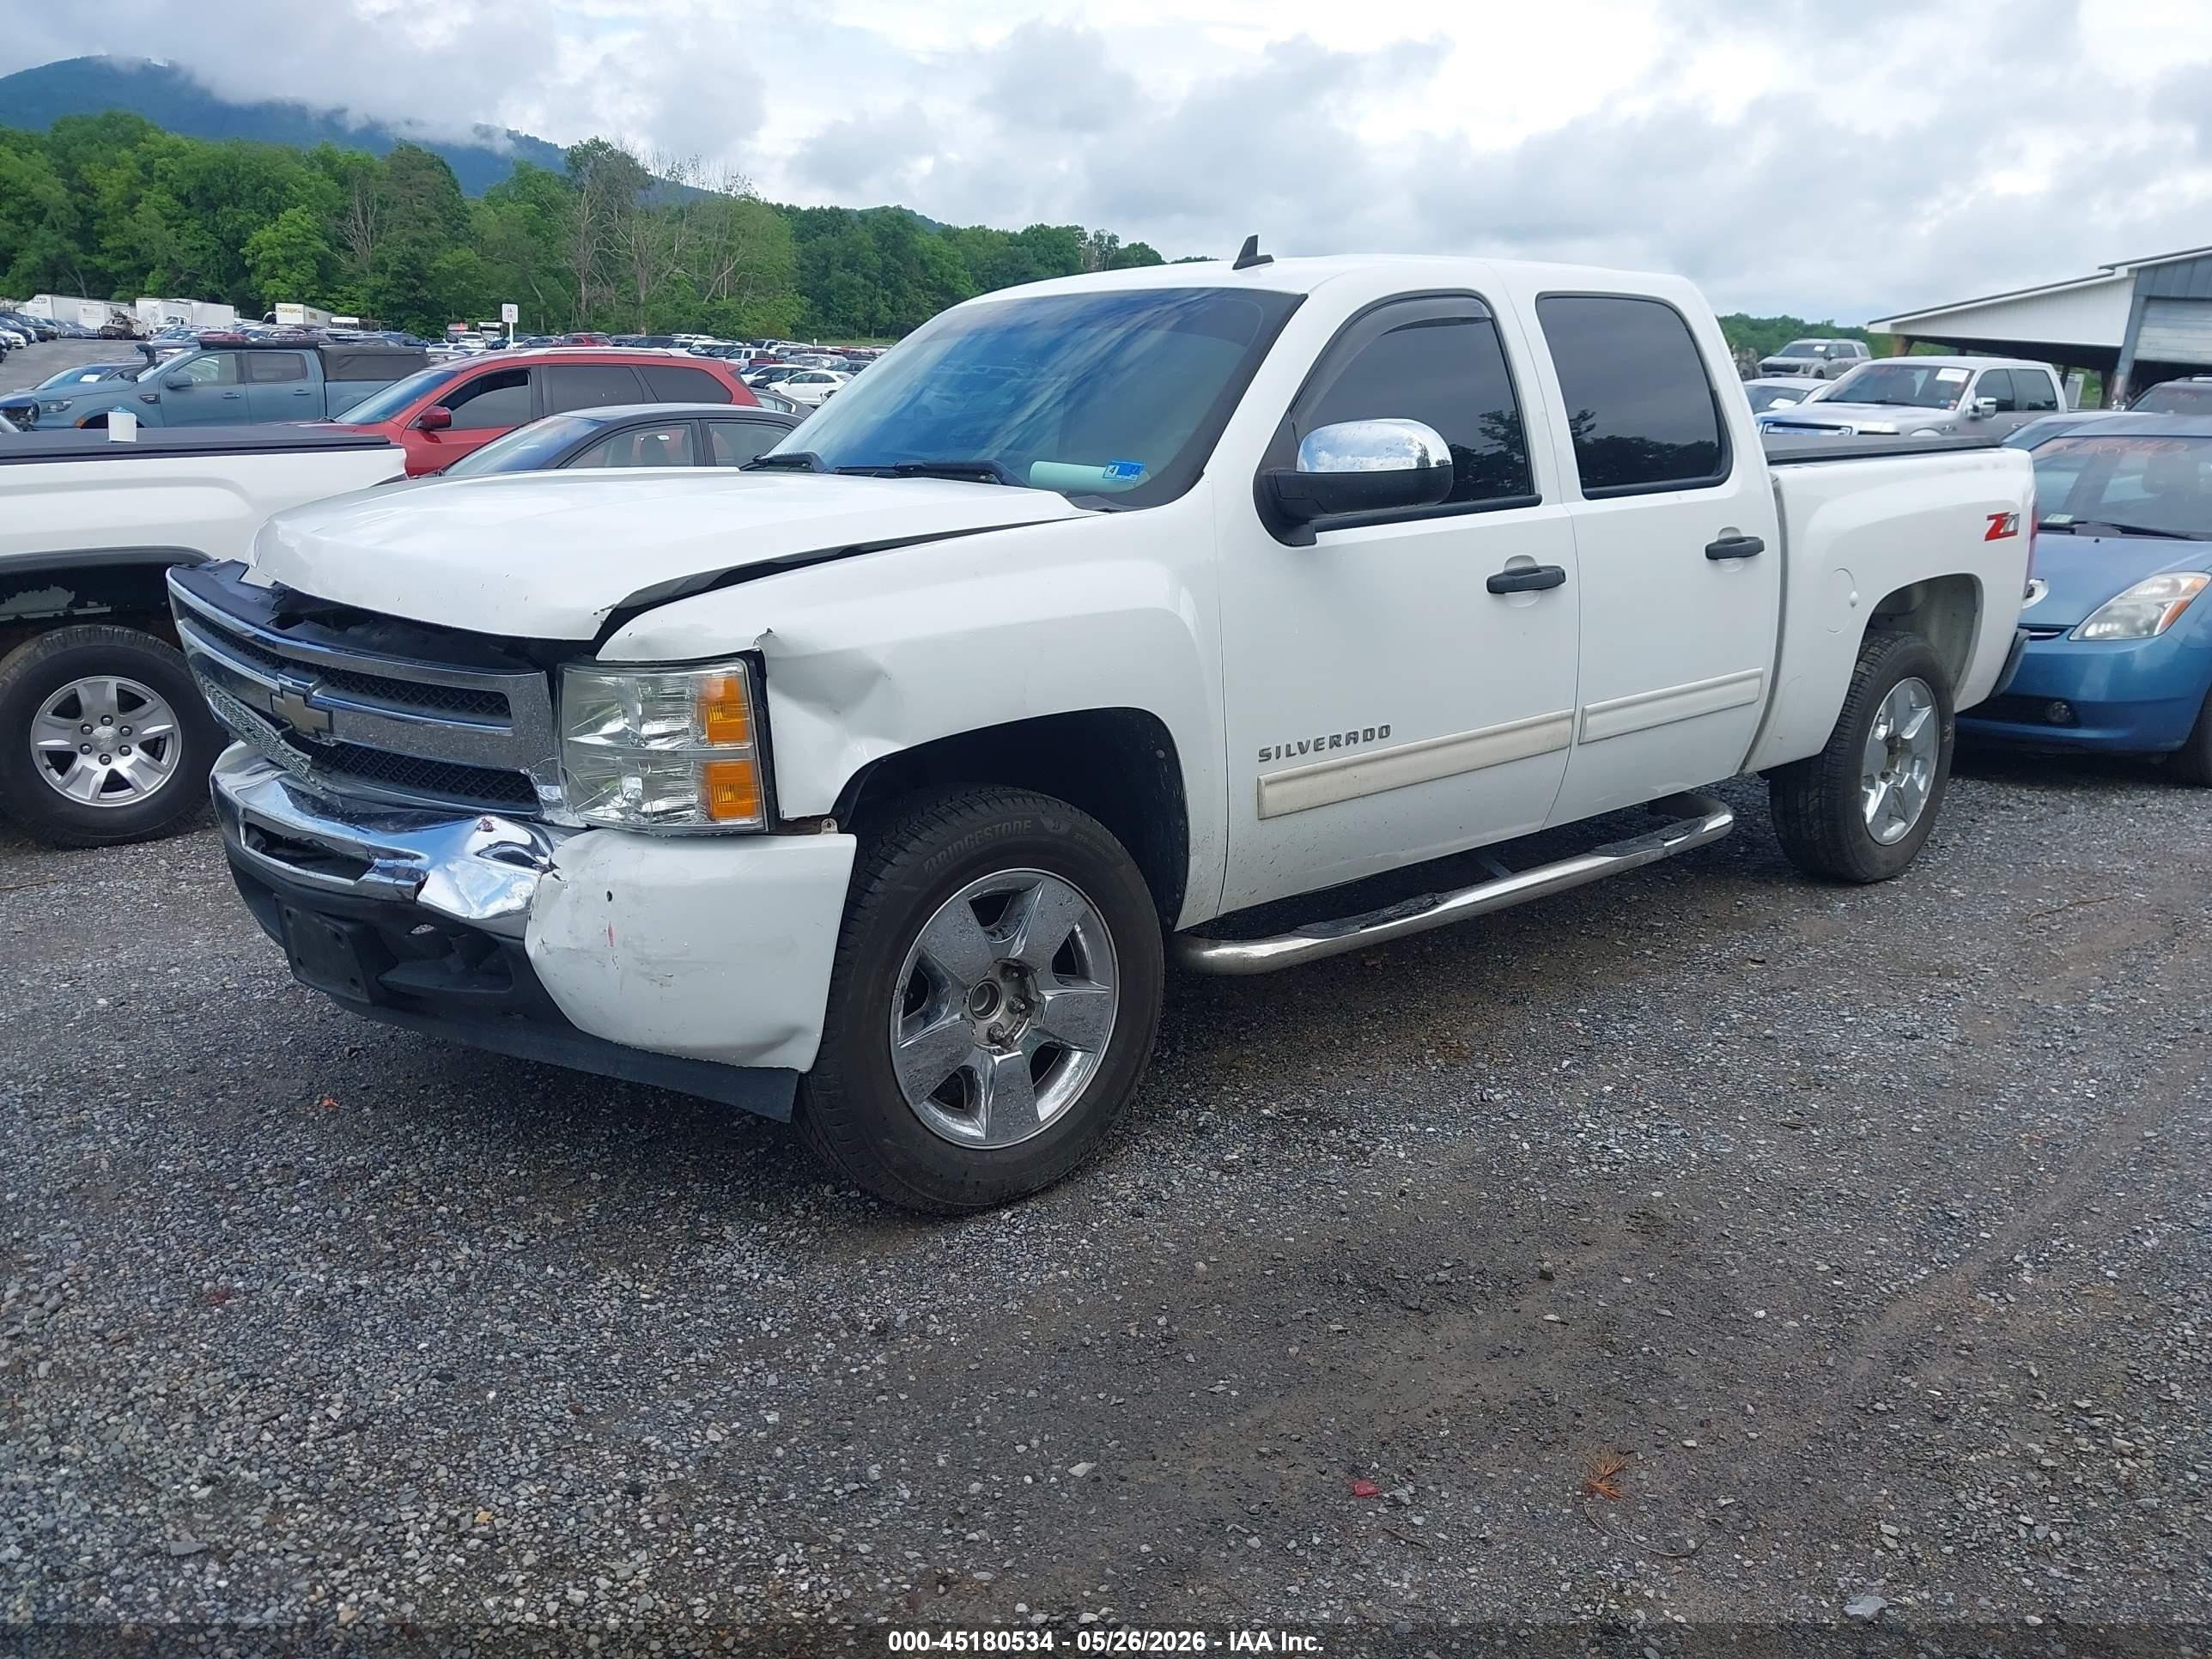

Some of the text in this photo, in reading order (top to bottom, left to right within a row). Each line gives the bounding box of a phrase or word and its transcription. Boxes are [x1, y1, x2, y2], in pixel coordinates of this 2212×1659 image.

[1984, 511, 2020, 542] Z71
[1257, 724, 1391, 763] SILVERADO
[923, 819, 1032, 873] BRIDGESTONE
